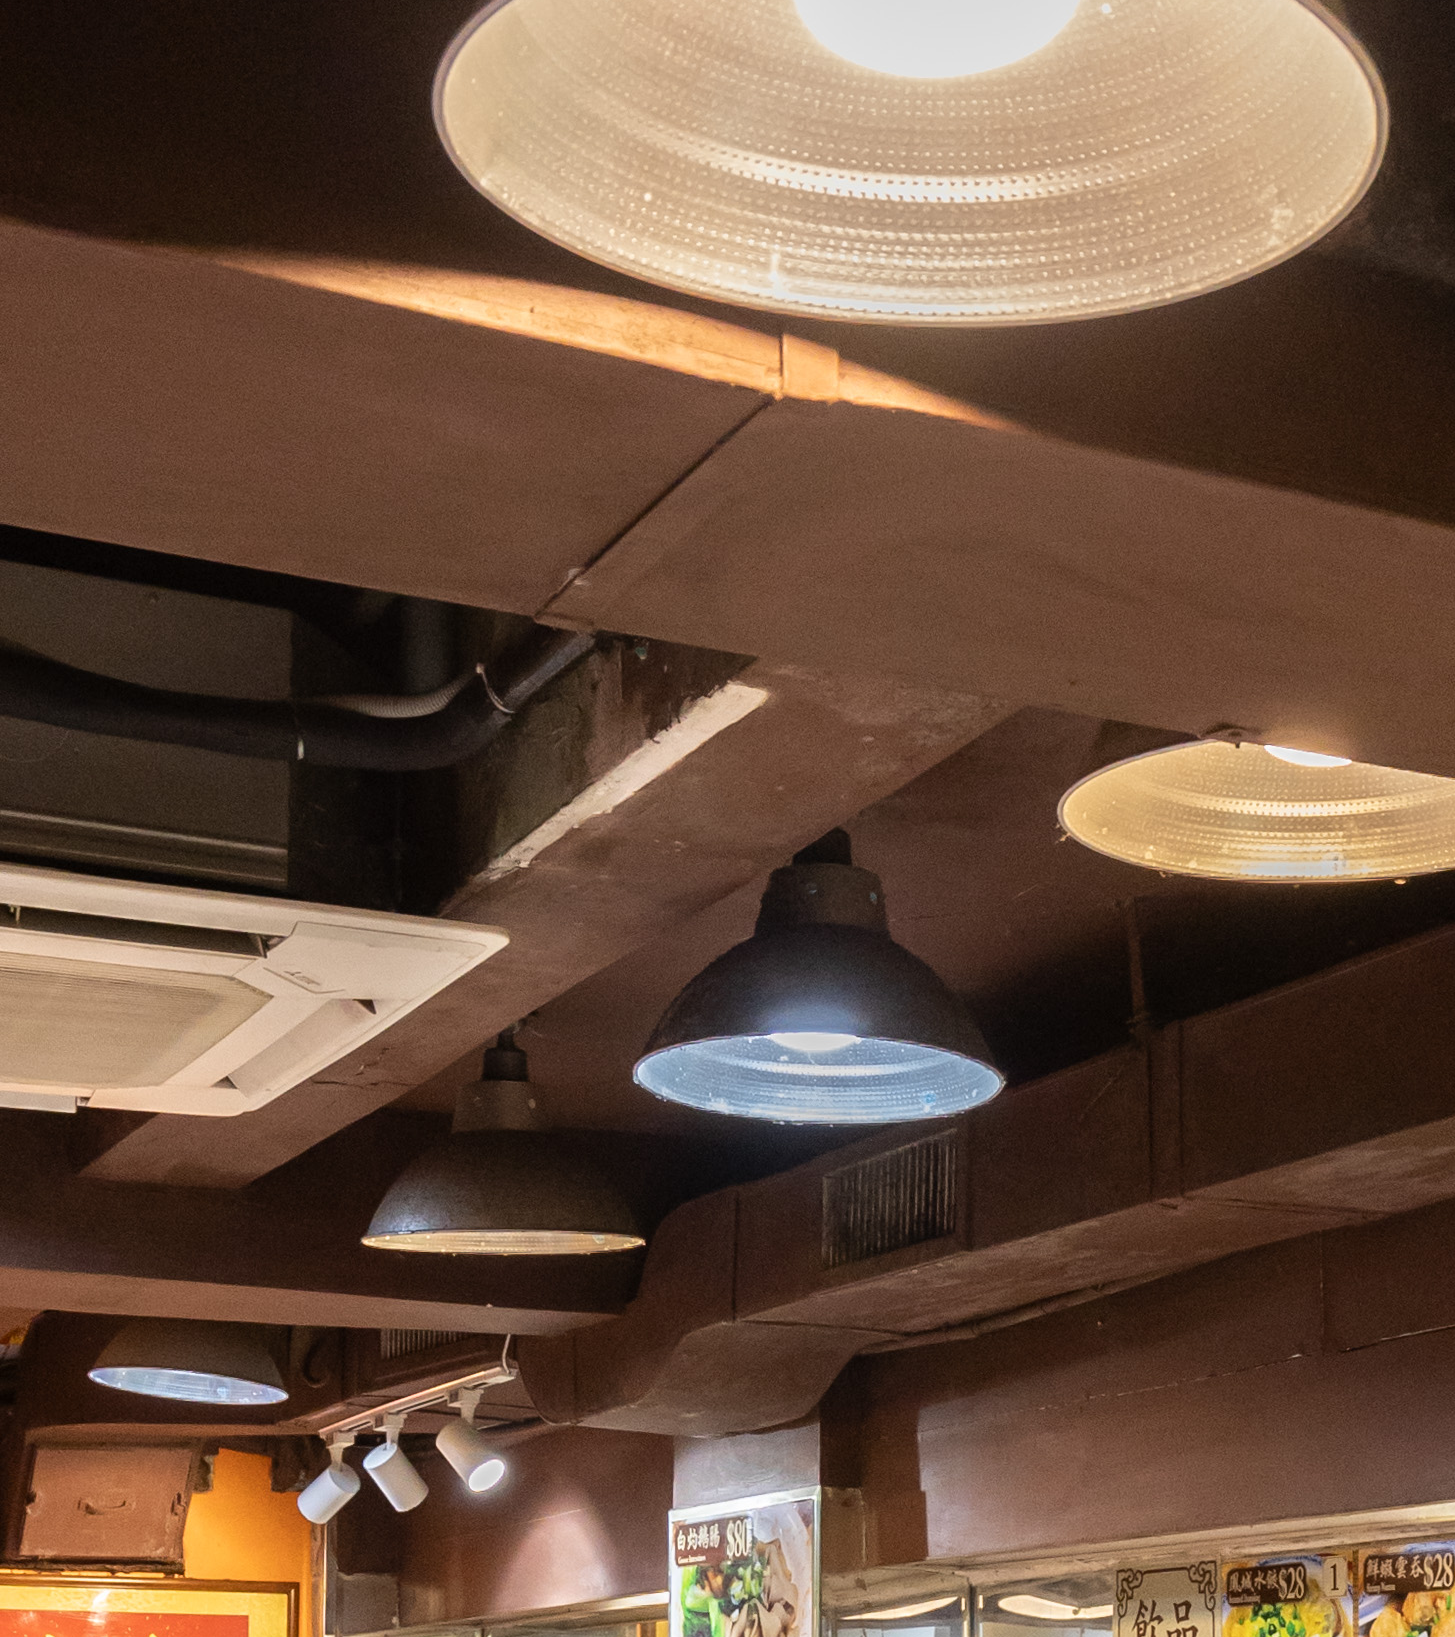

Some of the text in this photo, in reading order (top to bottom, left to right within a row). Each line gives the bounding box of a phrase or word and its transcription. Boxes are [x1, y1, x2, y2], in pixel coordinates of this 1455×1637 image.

[726, 1518, 752, 1560] $80
[1278, 1564, 1306, 1601] $28
[1330, 1562, 1339, 1592] 1
[1423, 1552, 1454, 1590] $28
